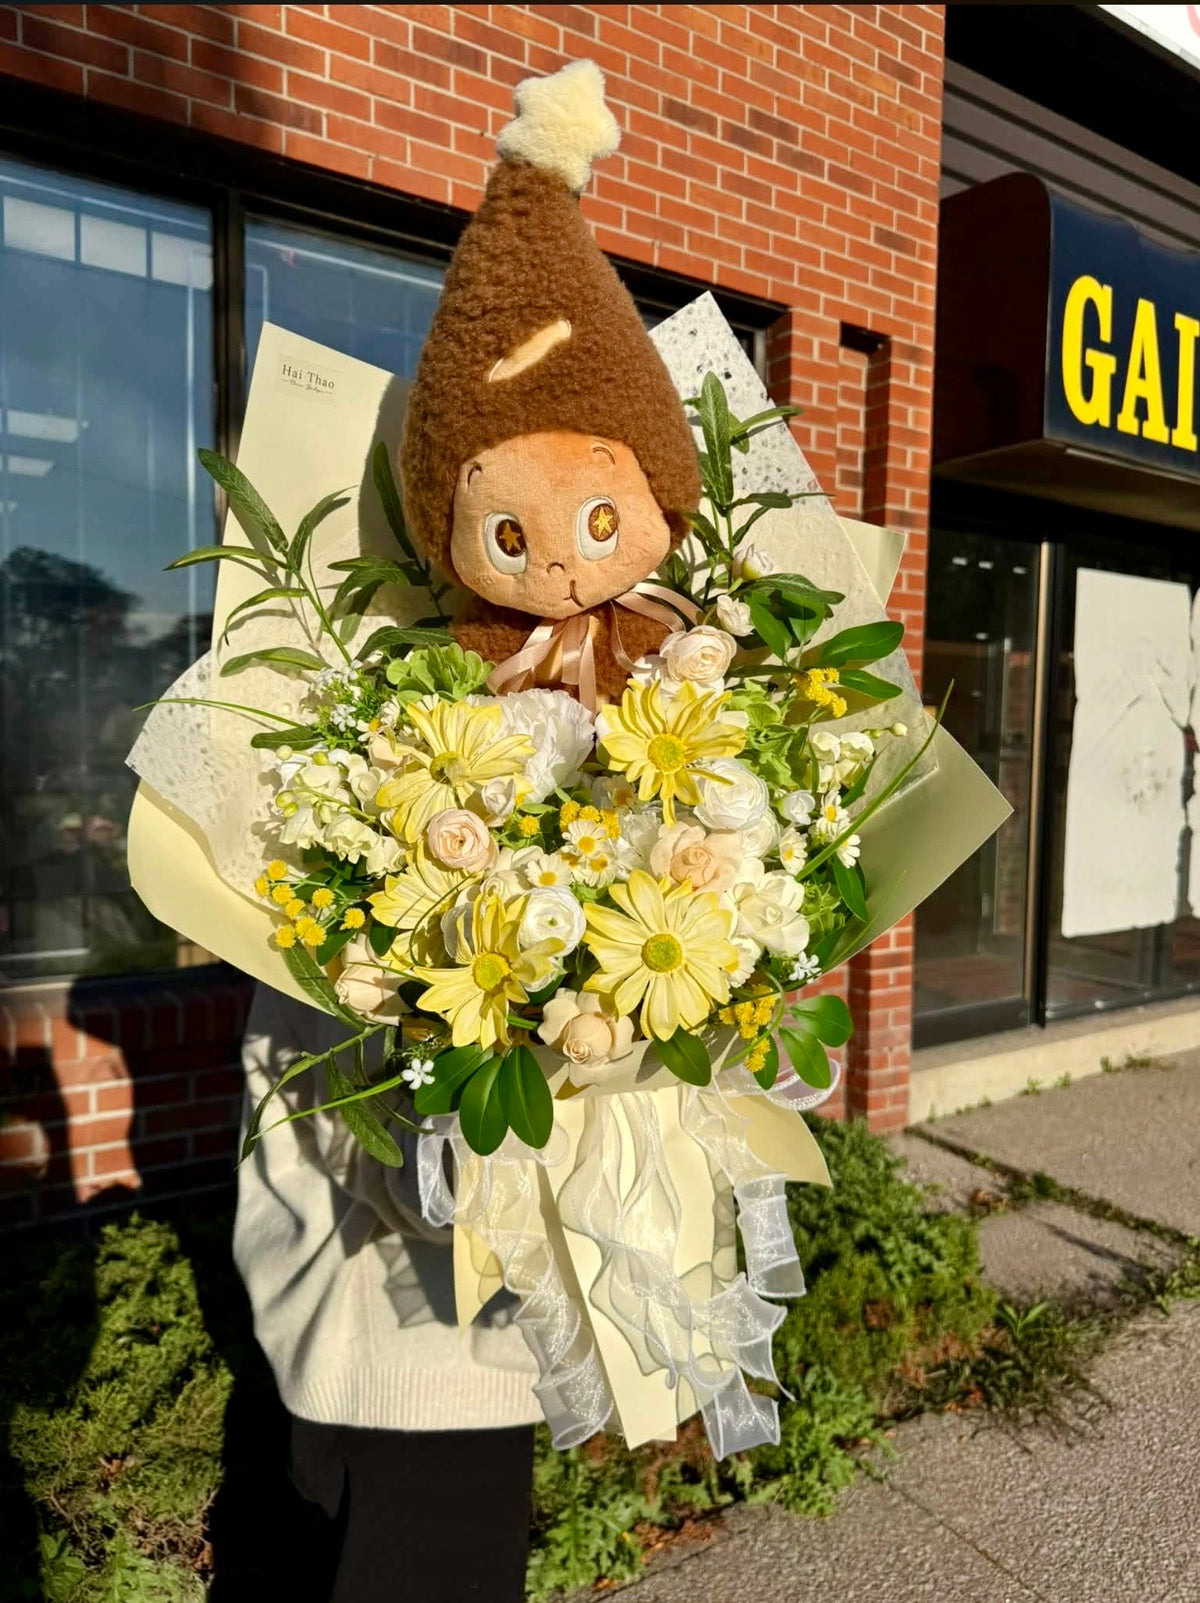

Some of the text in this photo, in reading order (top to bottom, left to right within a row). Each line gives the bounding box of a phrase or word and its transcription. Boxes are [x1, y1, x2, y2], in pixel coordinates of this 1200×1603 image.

[282, 364, 303, 380] Hai
[307, 371, 335, 389] Thao
[1062, 275, 1200, 452] GAI
